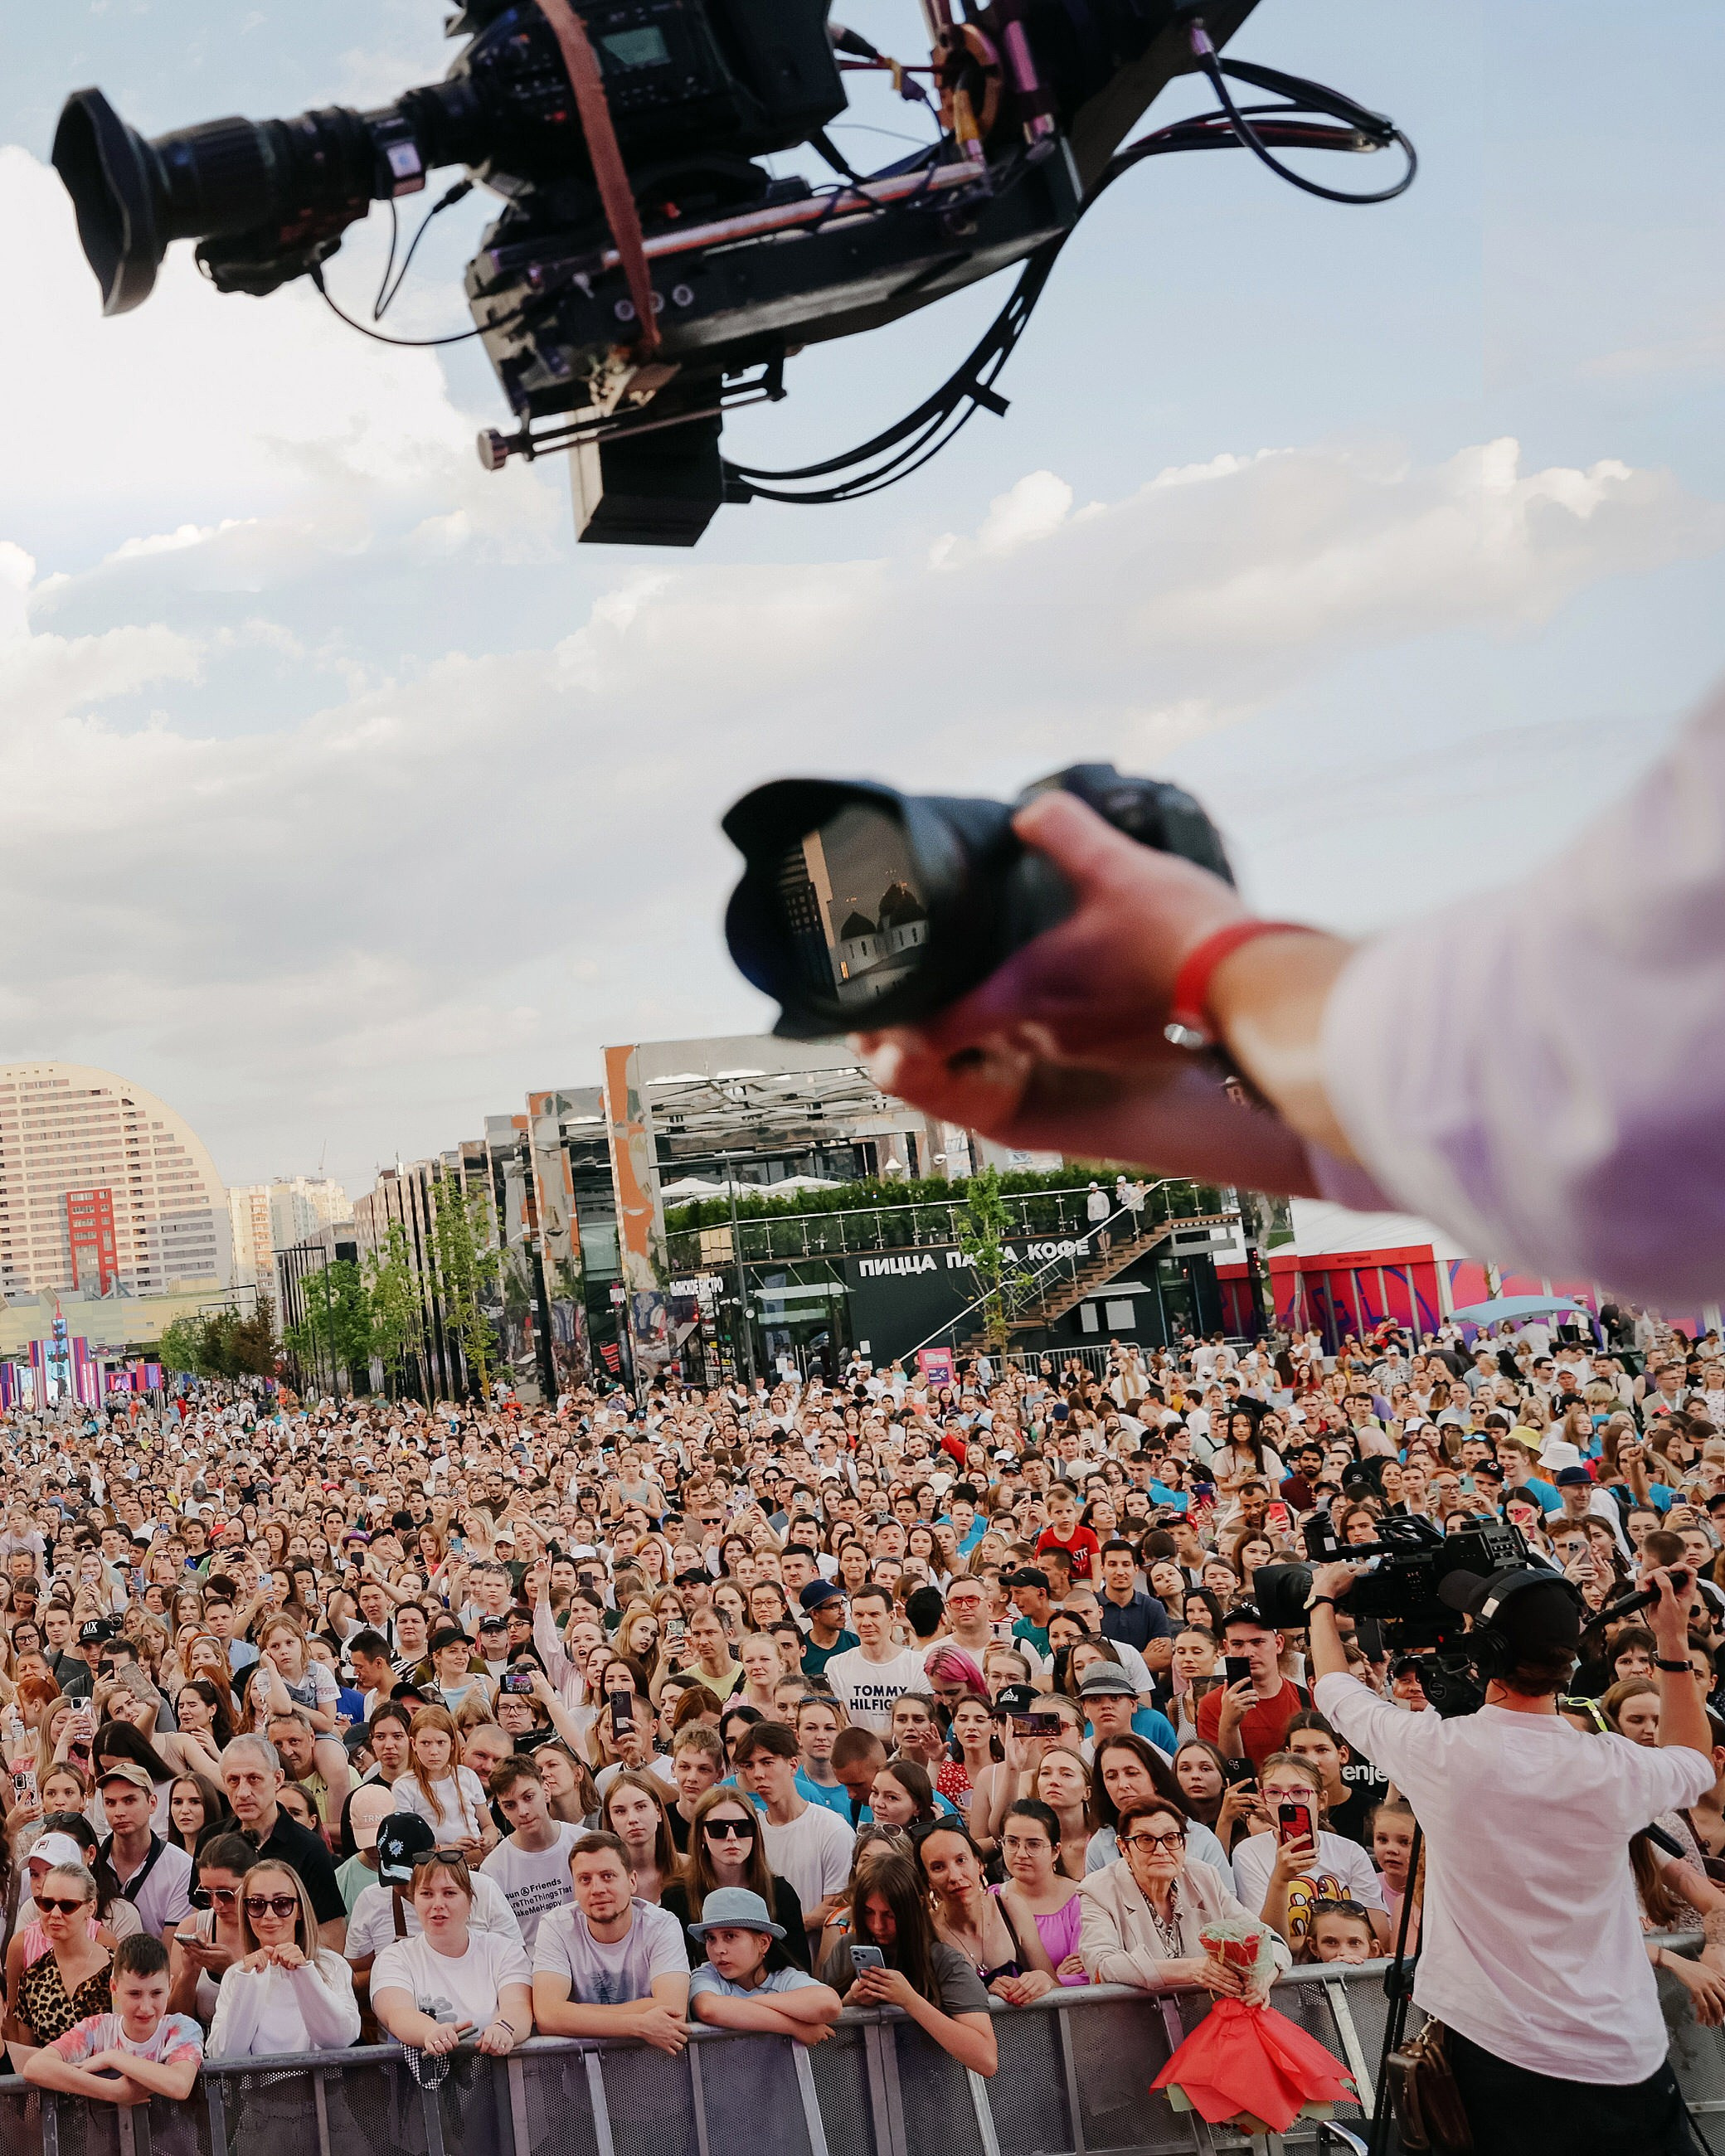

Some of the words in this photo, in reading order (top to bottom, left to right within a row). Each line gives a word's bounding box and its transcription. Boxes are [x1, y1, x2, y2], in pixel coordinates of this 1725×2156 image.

[859, 1254, 938, 1277] ПИЦЦА
[946, 1246, 1018, 1269] ПАА
[1027, 1240, 1091, 1260] КОФЕ
[853, 1685, 908, 1697] TOMMY
[530, 1878, 562, 1892] Friends
